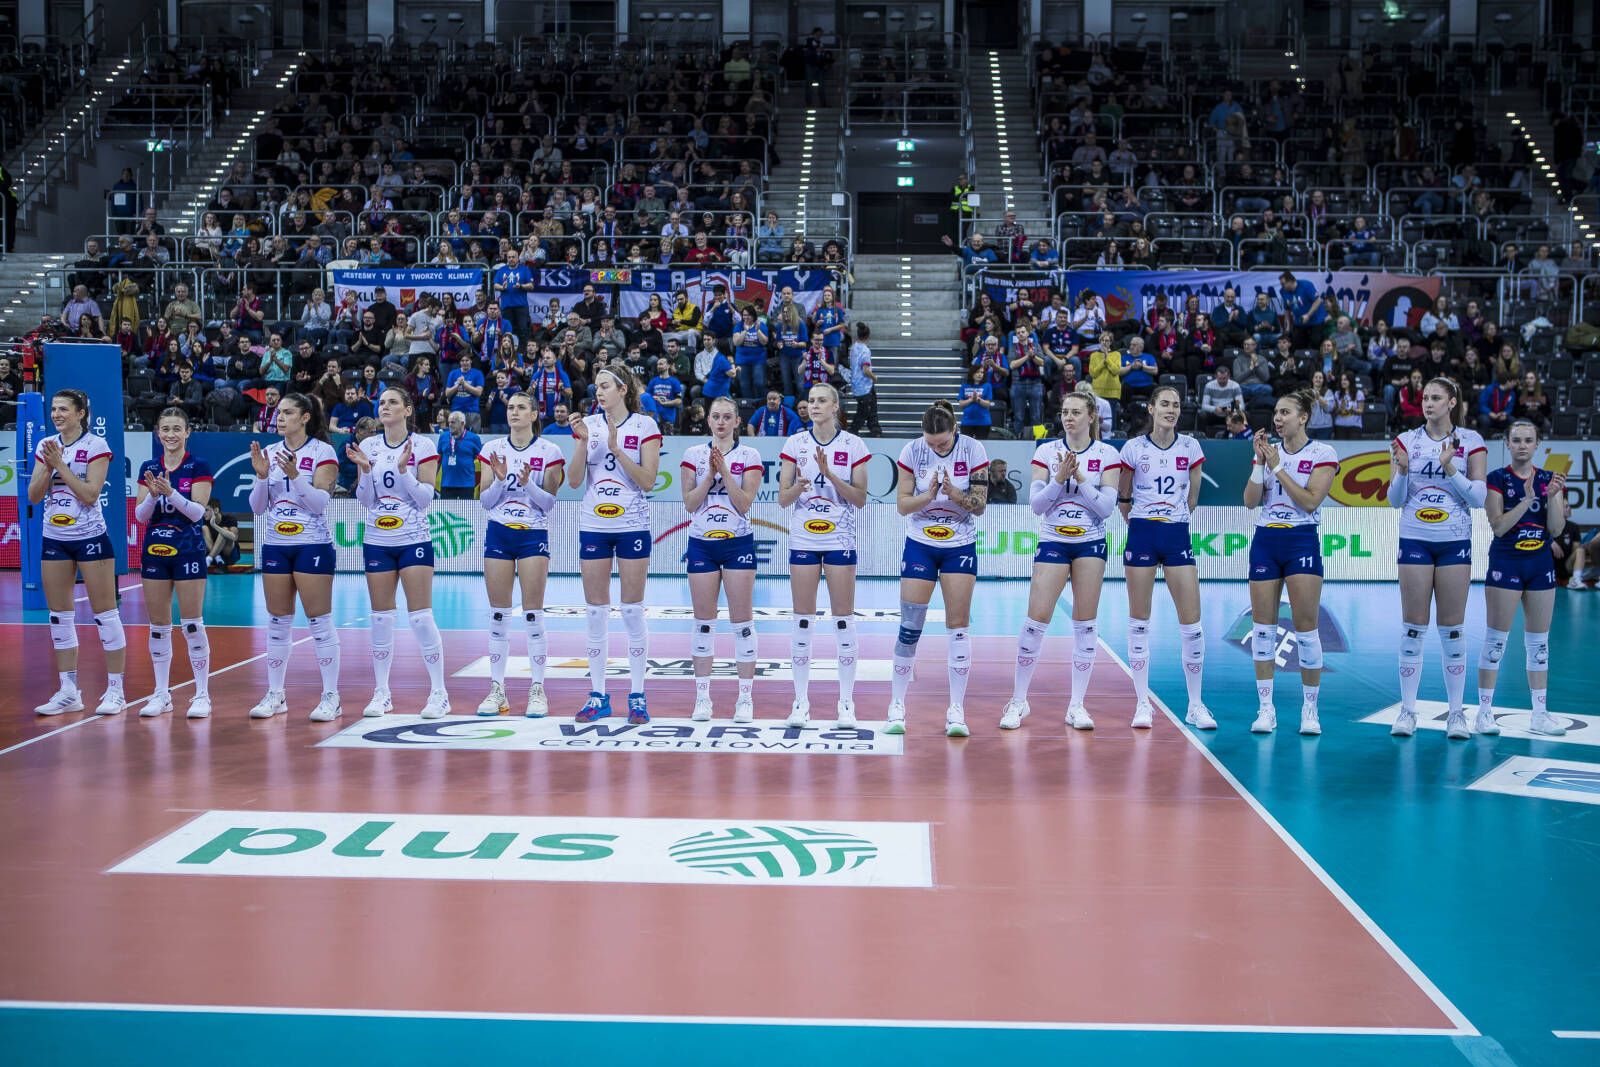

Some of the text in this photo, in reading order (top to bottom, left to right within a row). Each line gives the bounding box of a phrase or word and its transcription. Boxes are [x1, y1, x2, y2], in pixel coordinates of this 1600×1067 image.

[396, 273, 405, 281] BY
[448, 272, 474, 280] KLIMAT
[539, 268, 571, 287] KS
[604, 453, 617, 471] 3
[1420, 461, 1446, 479] 44
[383, 470, 395, 489] 6
[814, 472, 827, 489] 4
[1154, 475, 1175, 495] 12
[598, 487, 621, 497] PGE
[1418, 493, 1446, 504] PGE
[276, 507, 298, 517] PGE
[379, 502, 399, 511] PGE
[808, 503, 831, 513] PGE
[504, 508, 526, 518] PGE
[707, 513, 729, 523] PGE
[1058, 509, 1083, 519] PGE
[1269, 510, 1293, 520] PGE
[151, 528, 175, 538] PGE
[1517, 529, 1543, 539] PGE
[86, 543, 102, 555] 21
[633, 539, 643, 551] 3
[415, 547, 425, 559] 6
[312, 555, 321, 567] 1
[959, 555, 974, 568] 71
[1299, 555, 1313, 568] 11
[183, 561, 200, 575] 18
[539, 738, 874, 751] cementownia
[176, 821, 620, 864] plus
